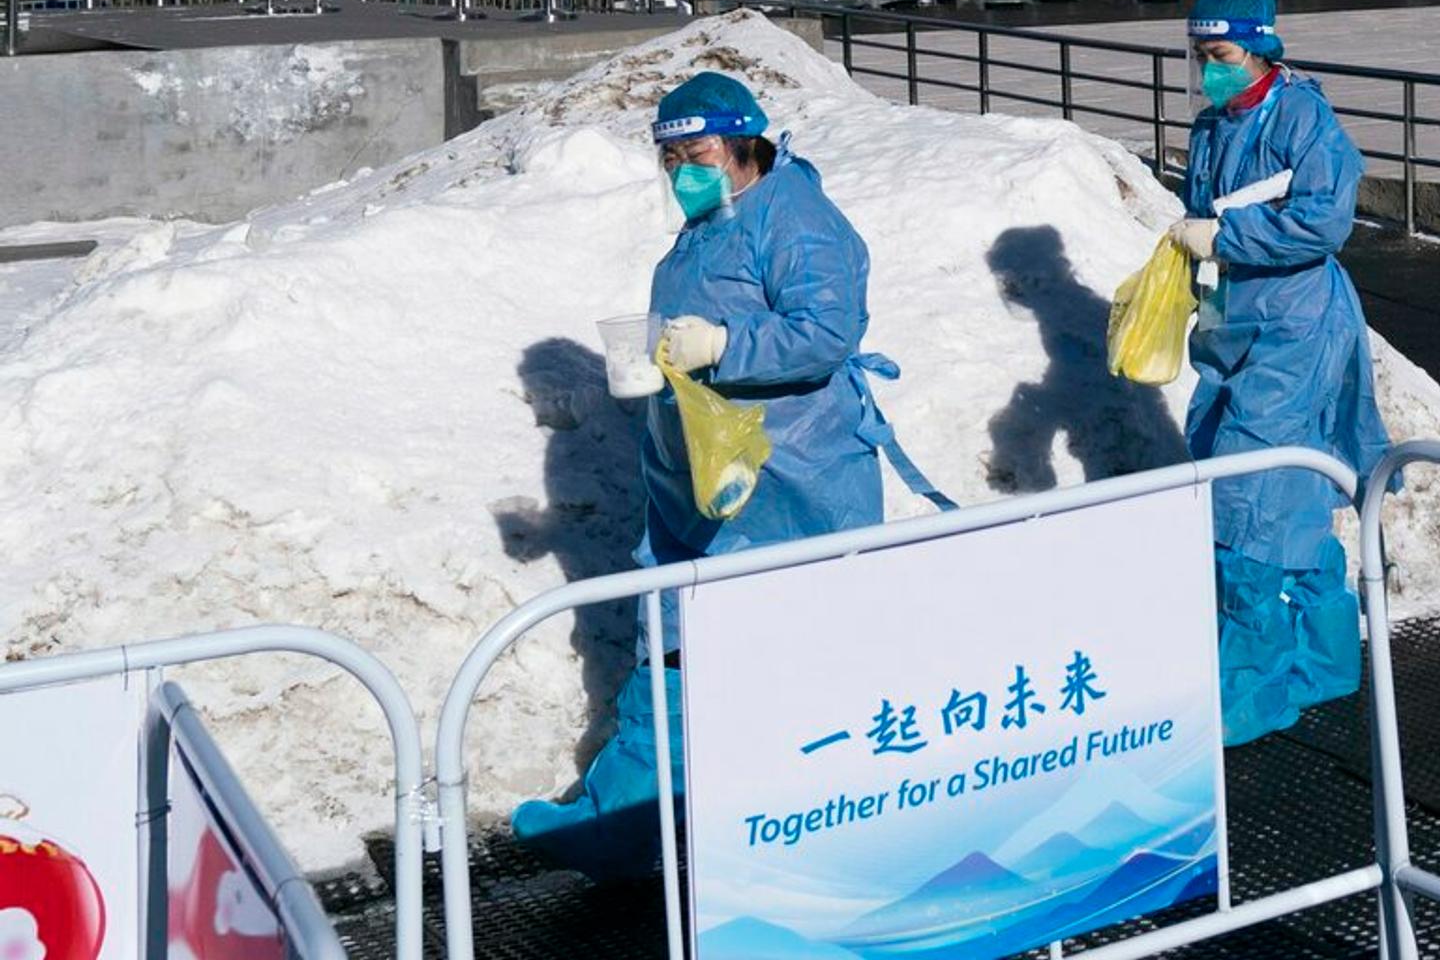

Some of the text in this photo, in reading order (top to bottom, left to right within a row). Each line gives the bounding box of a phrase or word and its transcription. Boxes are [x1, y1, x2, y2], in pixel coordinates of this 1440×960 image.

[800, 649, 1107, 756] 一起向未来
[743, 719, 1174, 847] Together for a Shared Future
